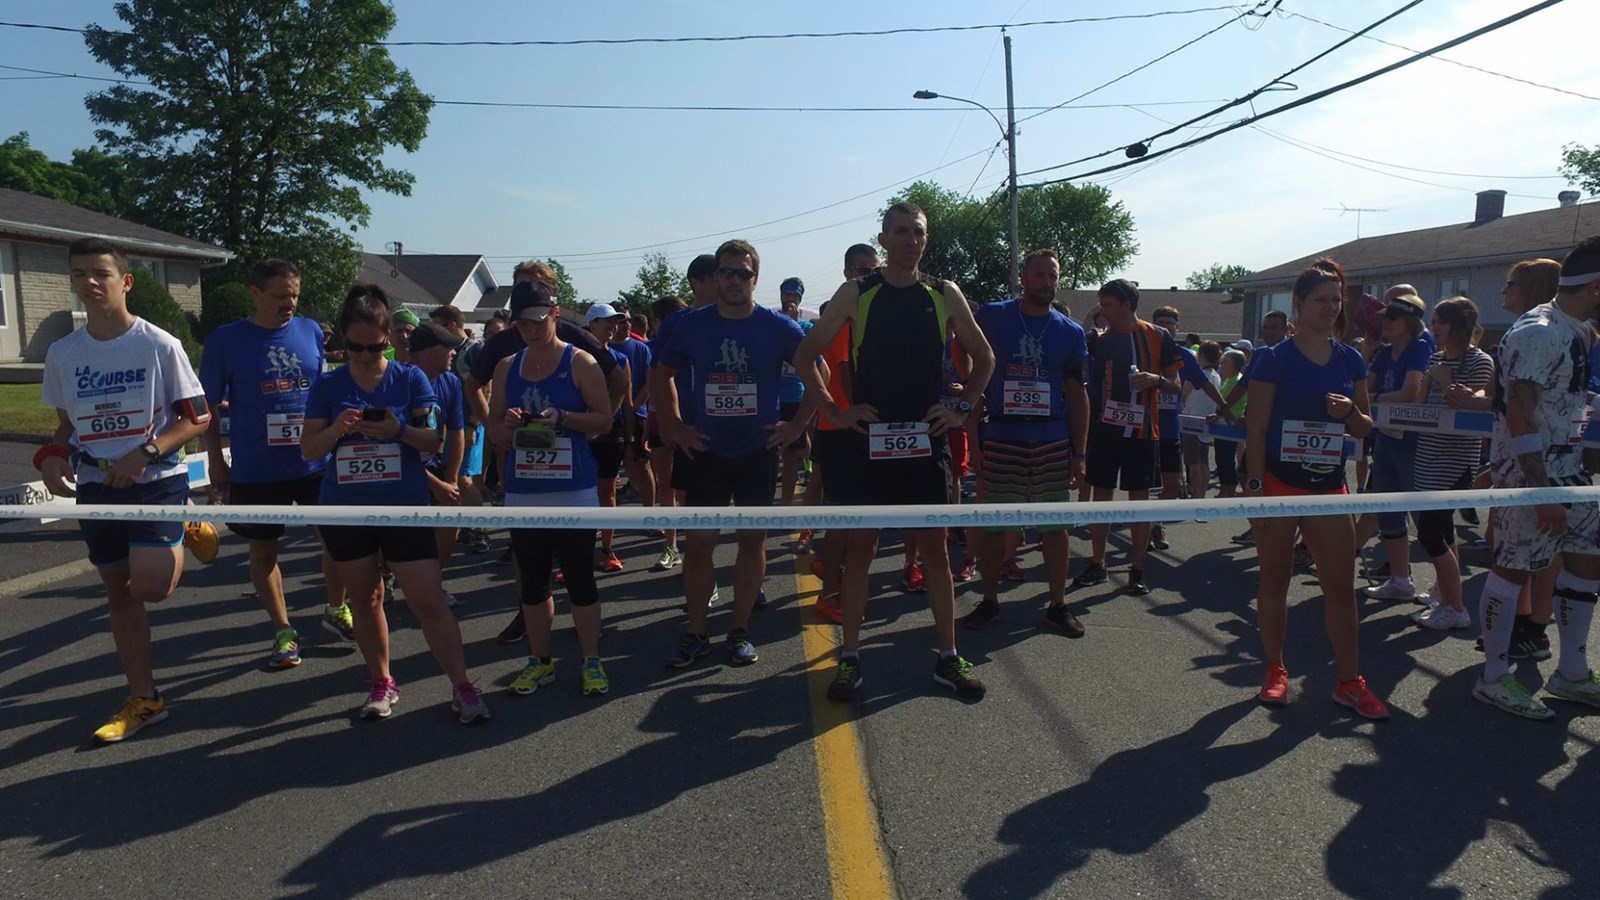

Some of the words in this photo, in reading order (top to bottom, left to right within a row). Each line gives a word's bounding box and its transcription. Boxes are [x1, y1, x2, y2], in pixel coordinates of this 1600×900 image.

[75, 366, 90, 377] LA
[78, 368, 146, 389] COURSE
[715, 396, 745, 409] 584
[1013, 392, 1041, 403] 639
[1112, 410, 1135, 422] 578
[1388, 406, 1441, 421] POMERLEAU
[91, 415, 130, 433] 669
[281, 425, 301, 438] 51
[884, 436, 918, 450] 562
[1297, 435, 1331, 449] 507
[525, 451, 558, 464] 527
[349, 458, 386, 475] 526
[353, 473, 383, 481] CHANTALE
[1560, 598, 1574, 626] ebao
